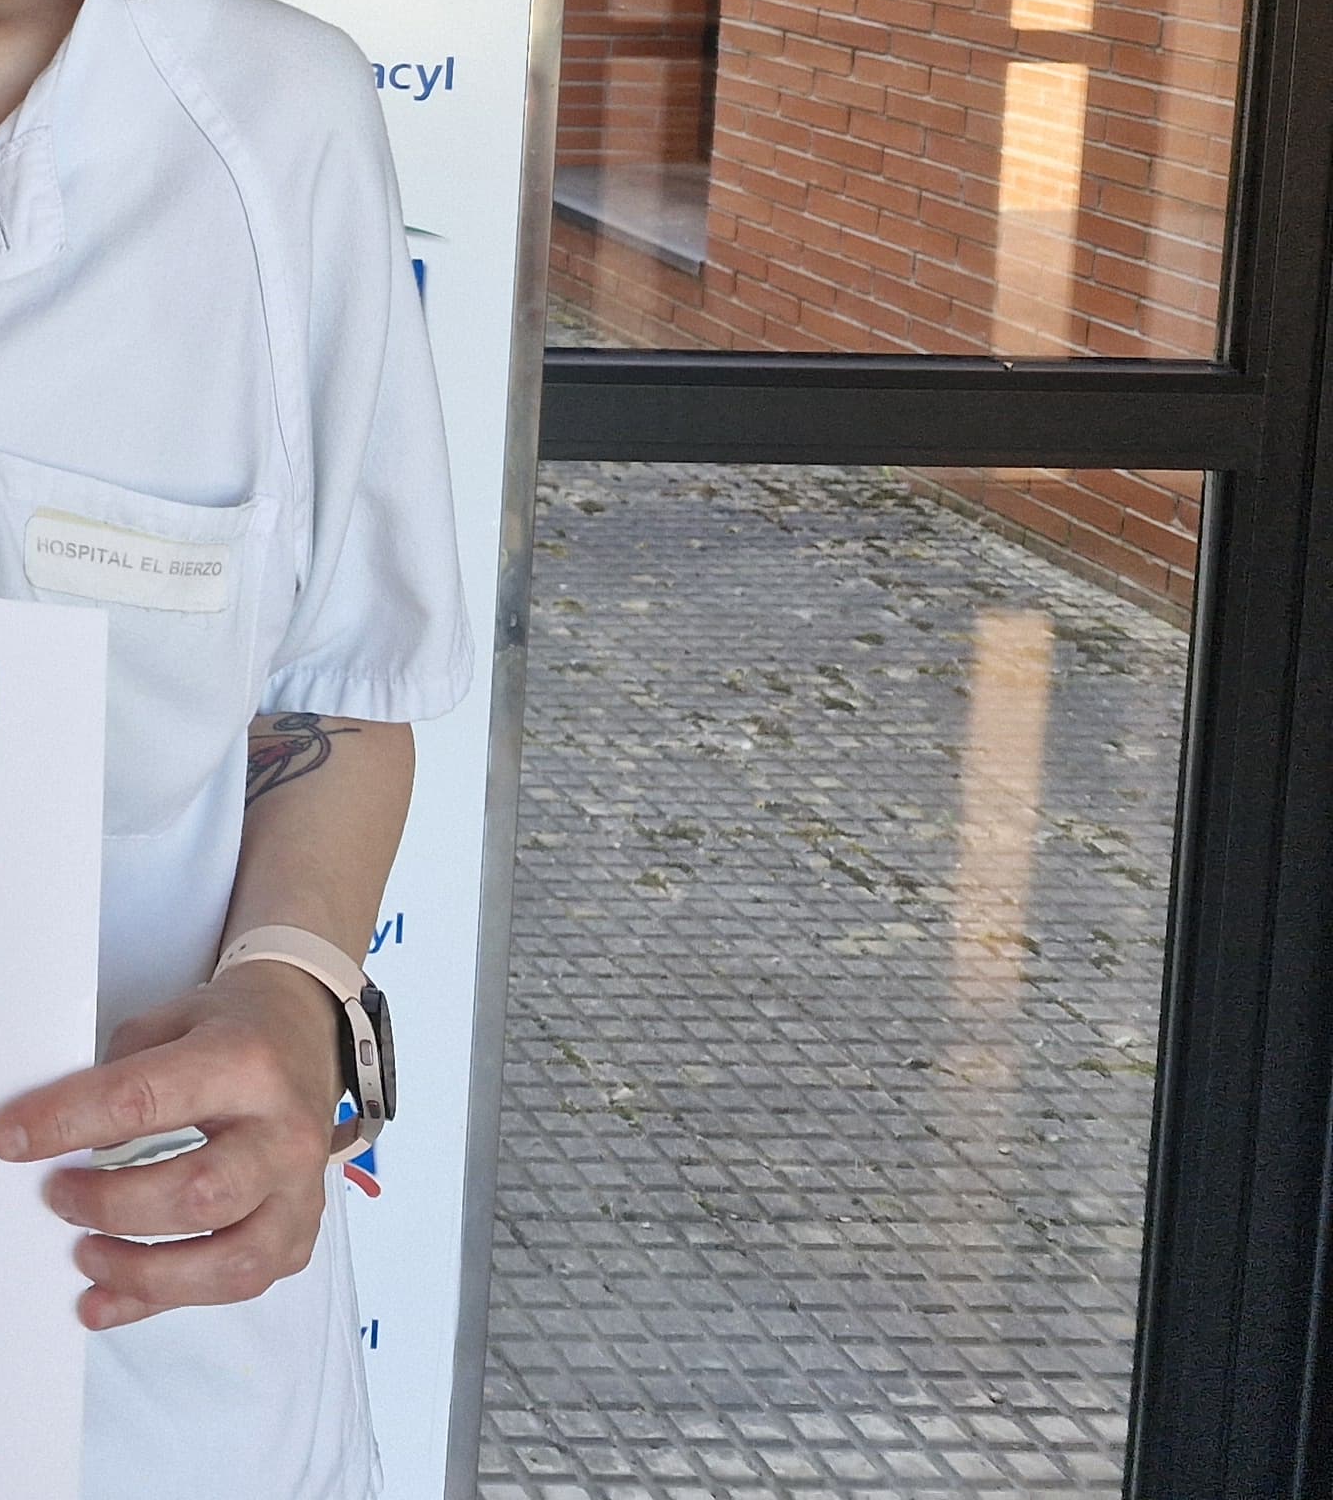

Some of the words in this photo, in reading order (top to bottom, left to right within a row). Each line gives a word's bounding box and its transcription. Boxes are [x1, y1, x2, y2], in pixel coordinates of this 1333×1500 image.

[36, 536, 133, 569] HOSPITAL
[140, 556, 163, 575] EL
[168, 560, 222, 577] BIERZO
